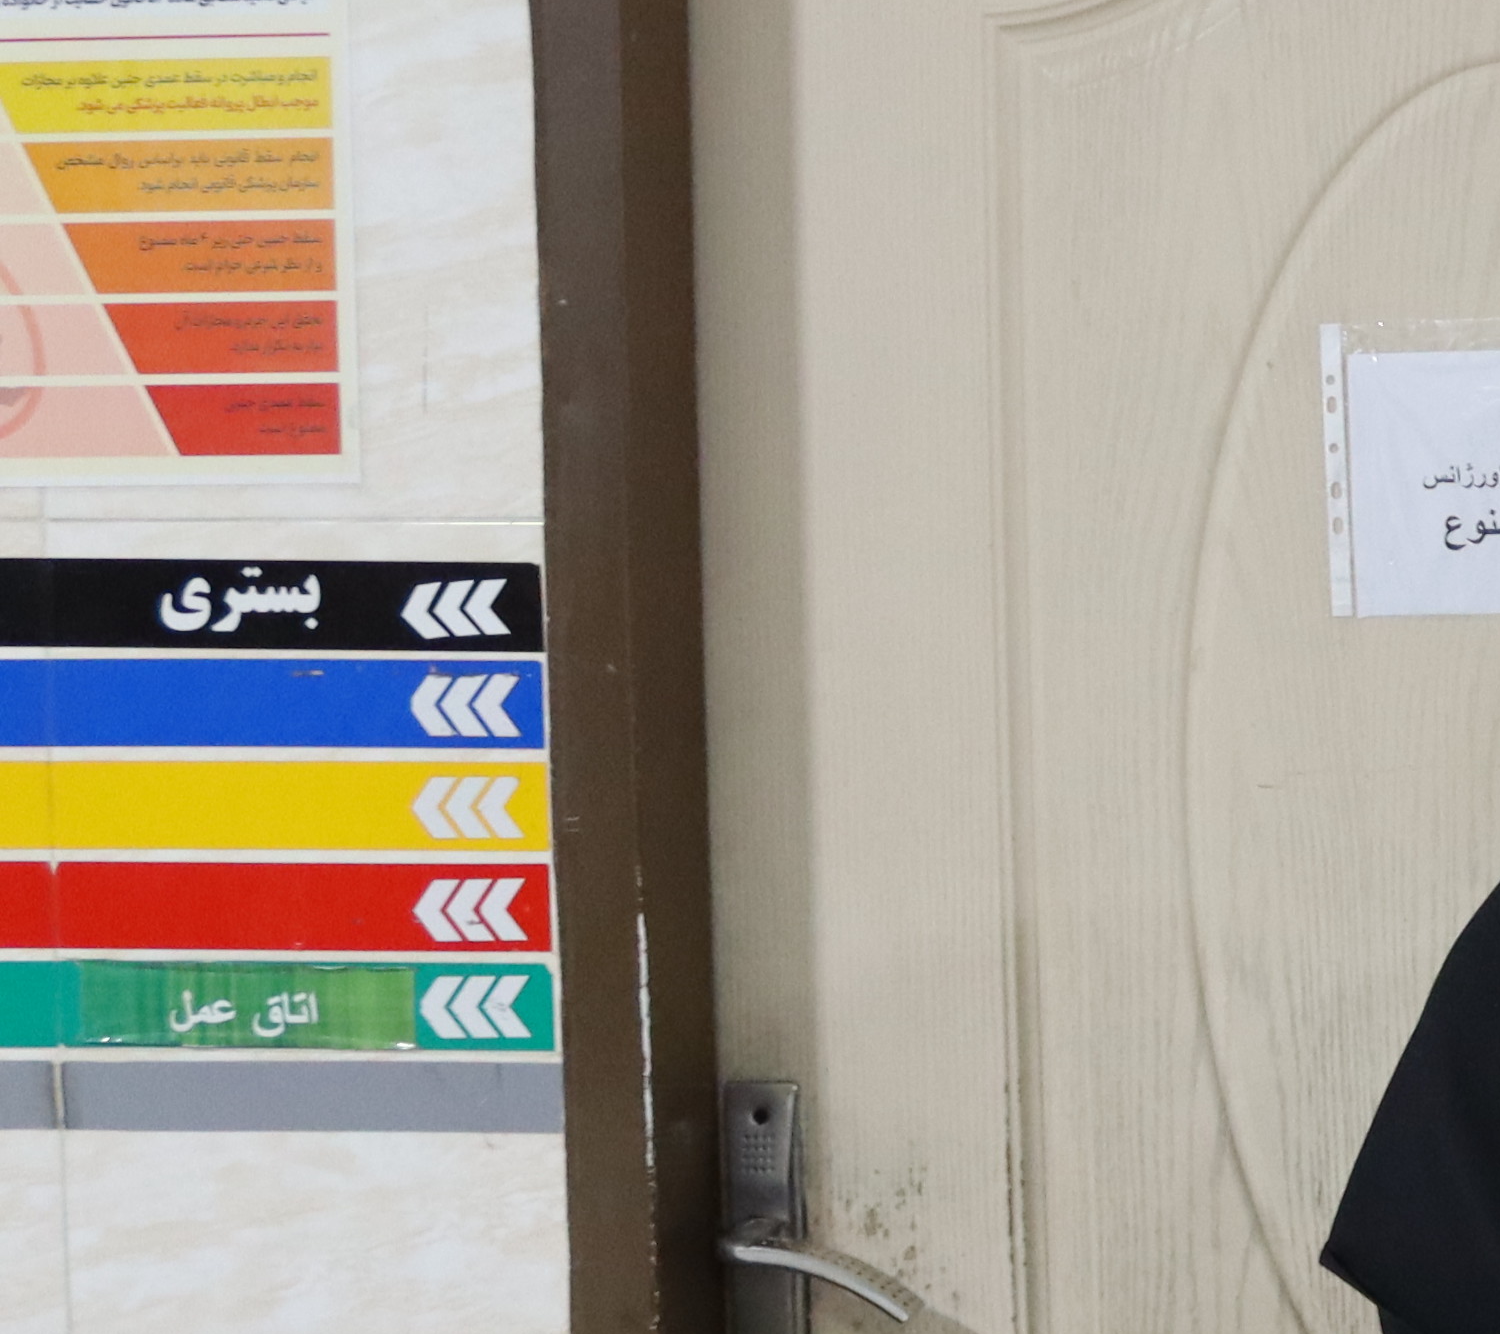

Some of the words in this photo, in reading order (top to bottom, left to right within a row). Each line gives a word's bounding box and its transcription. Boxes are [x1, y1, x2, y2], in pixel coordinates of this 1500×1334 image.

[159, 567, 321, 632] بستری
[169, 989, 236, 1032] عمل
[252, 990, 319, 1037] اتاق
